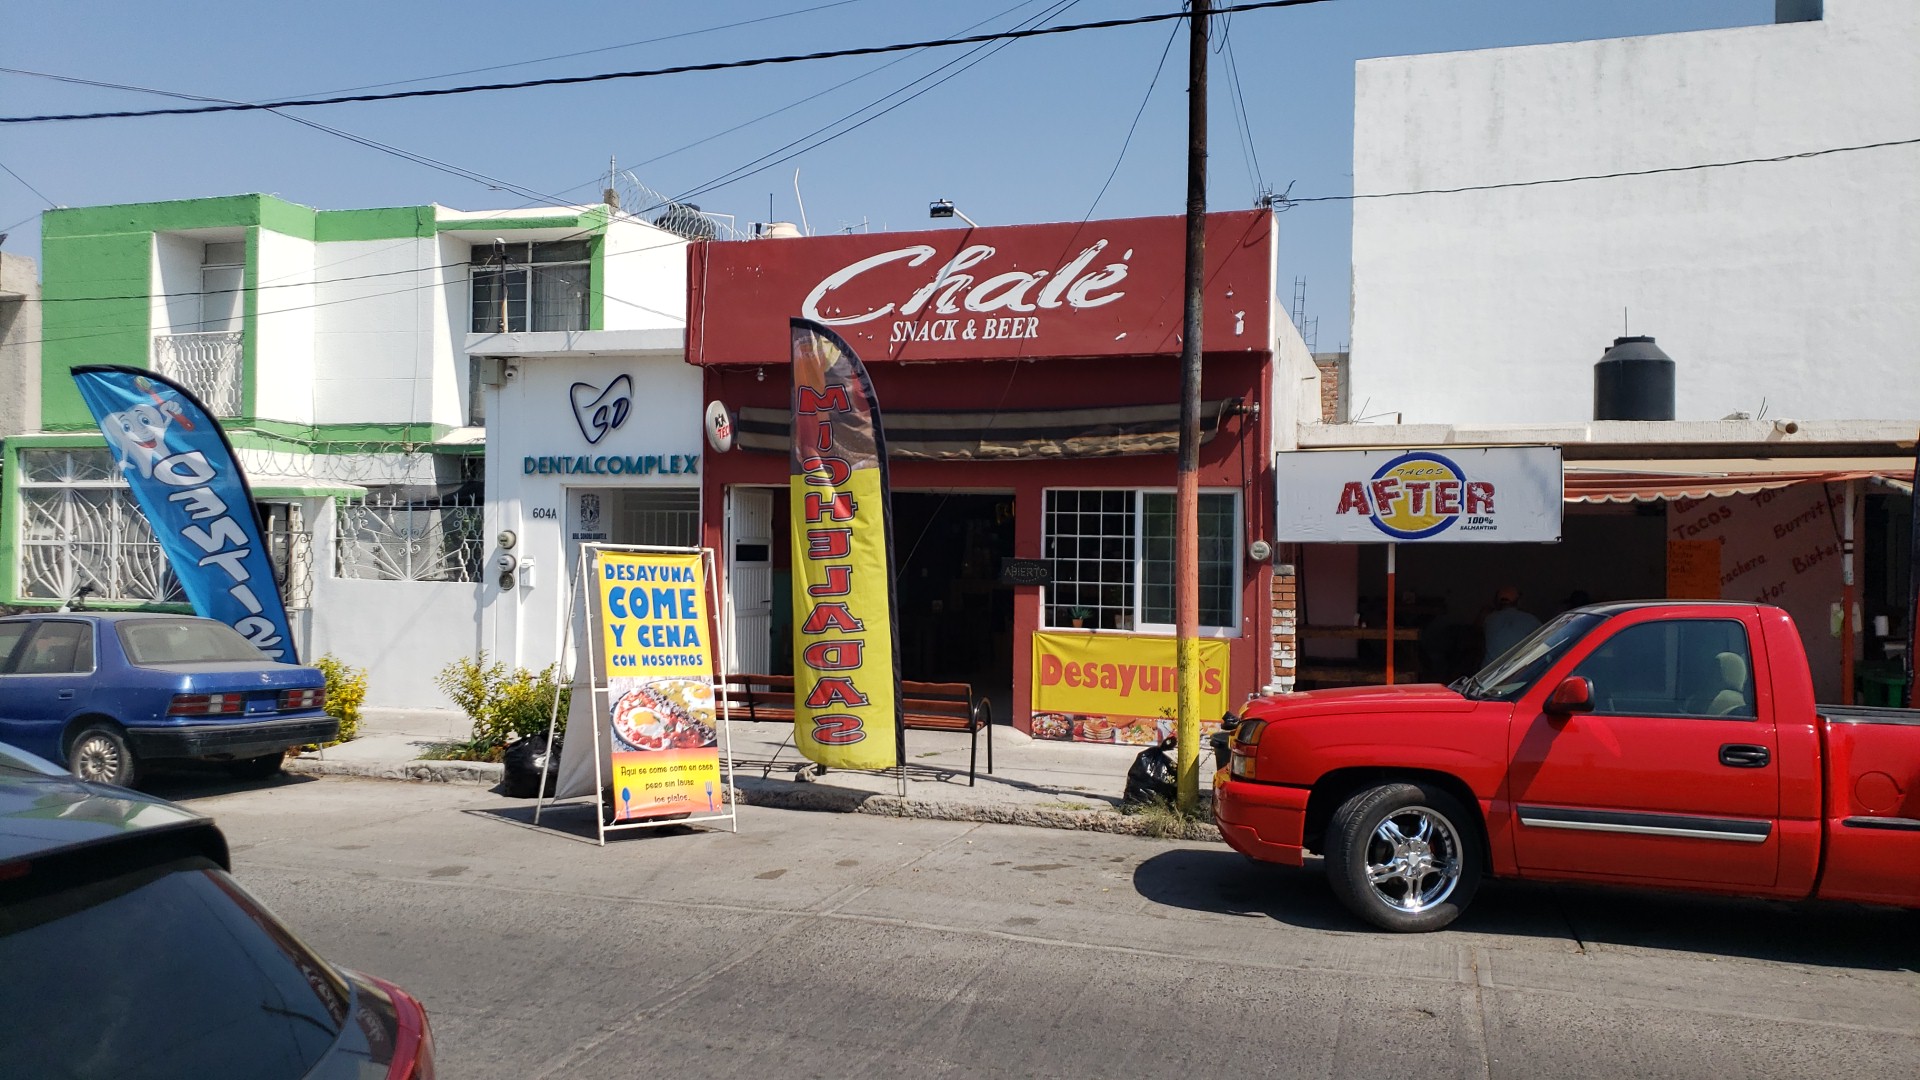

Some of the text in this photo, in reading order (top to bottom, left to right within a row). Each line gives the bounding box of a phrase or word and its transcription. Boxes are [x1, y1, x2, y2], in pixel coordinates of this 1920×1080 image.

[890, 317, 1039, 342] SNACK & BEER
[524, 456, 698, 475] DENTALCOMPLEX
[1336, 478, 1495, 516] AFTER
[532, 507, 557, 520] 604A
[1467, 516, 1494, 525] 100%
[1673, 505, 1732, 540] Tacos
[605, 563, 695, 582] DESAYUNA
[1005, 566, 1048, 578] ABIERTO
[608, 586, 698, 619] COME
[610, 624, 701, 647] Y CENA
[612, 654, 703, 666] CON NOSOTROS
[1041, 653, 1221, 697] Desayuns
[699, 763, 713, 771] casa
[645, 782, 663, 791] pero
[654, 795, 664, 803] los
